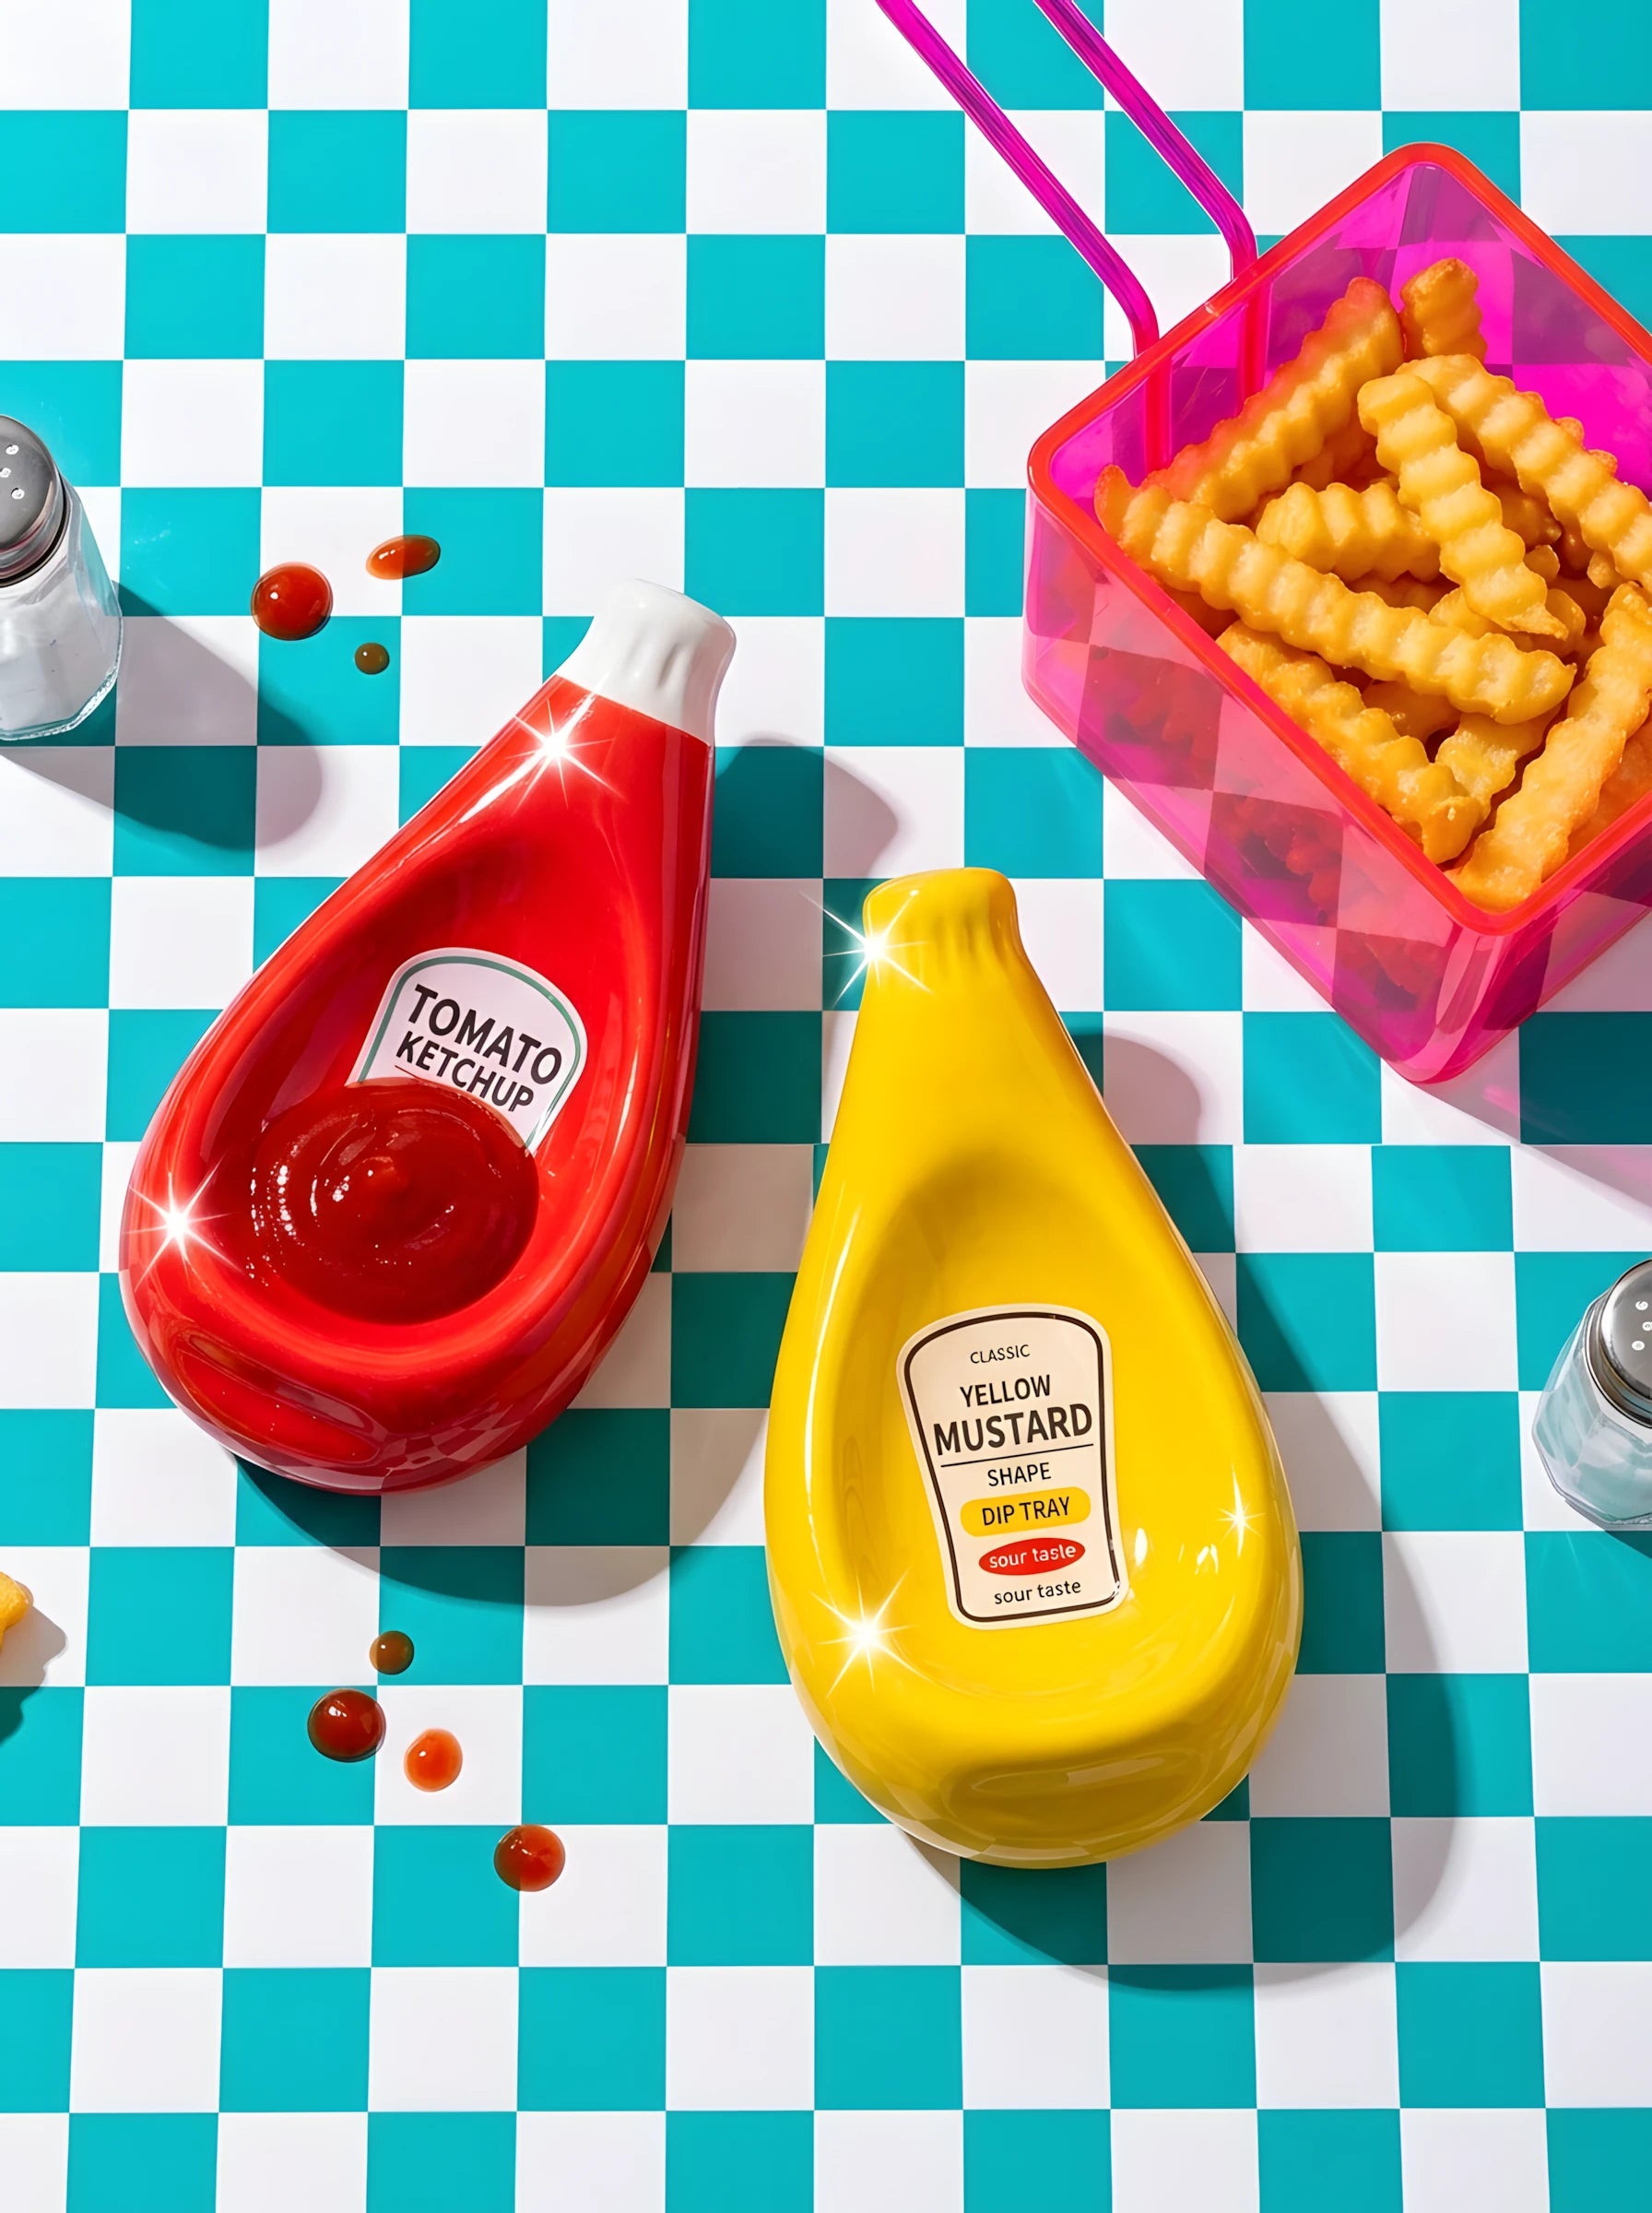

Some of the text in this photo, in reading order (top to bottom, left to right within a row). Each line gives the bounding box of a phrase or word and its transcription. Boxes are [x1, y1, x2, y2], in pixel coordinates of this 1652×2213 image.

[408, 984, 562, 1084] TOMATO
[395, 1031, 534, 1112] KETCHUP
[970, 1344, 1031, 1364] CLASSIC
[960, 1375, 1051, 1407] YELLOW
[933, 1403, 1092, 1456] MUSTARD
[987, 1462, 1051, 1486] SHAPE
[982, 1497, 1070, 1526] DIP TRAY
[989, 1552, 1027, 1568] sour
[994, 1580, 1081, 1604] sour taste
